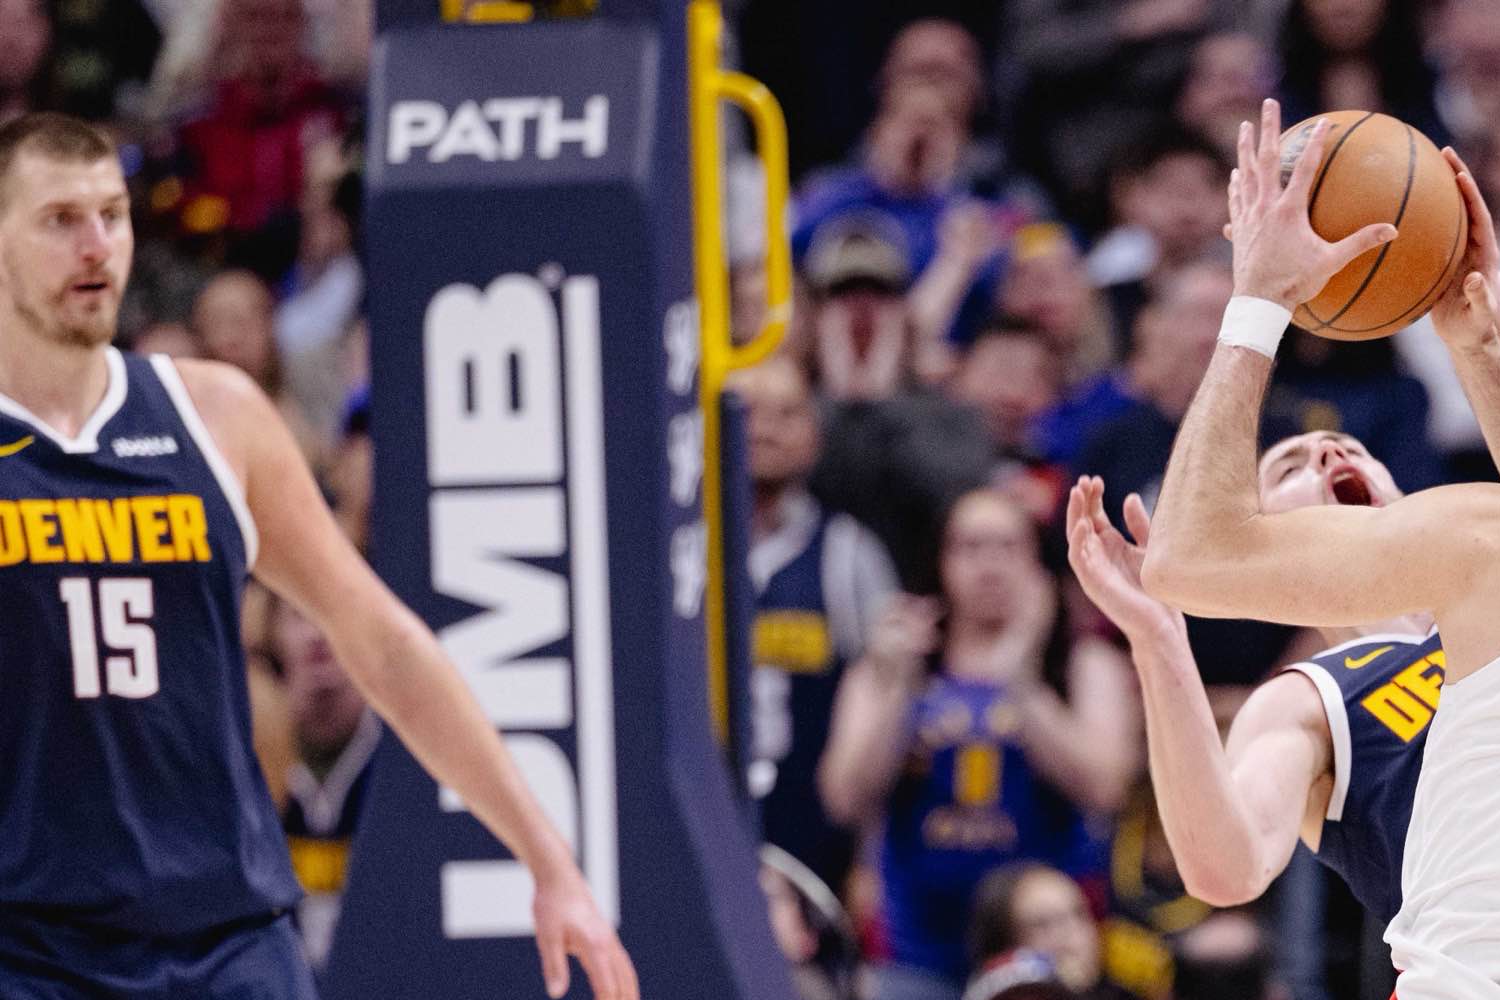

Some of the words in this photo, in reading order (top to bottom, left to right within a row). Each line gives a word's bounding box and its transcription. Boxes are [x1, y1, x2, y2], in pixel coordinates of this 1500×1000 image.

[386, 95, 609, 164] PATH
[0, 494, 212, 567] DENVER
[59, 577, 160, 699] 15
